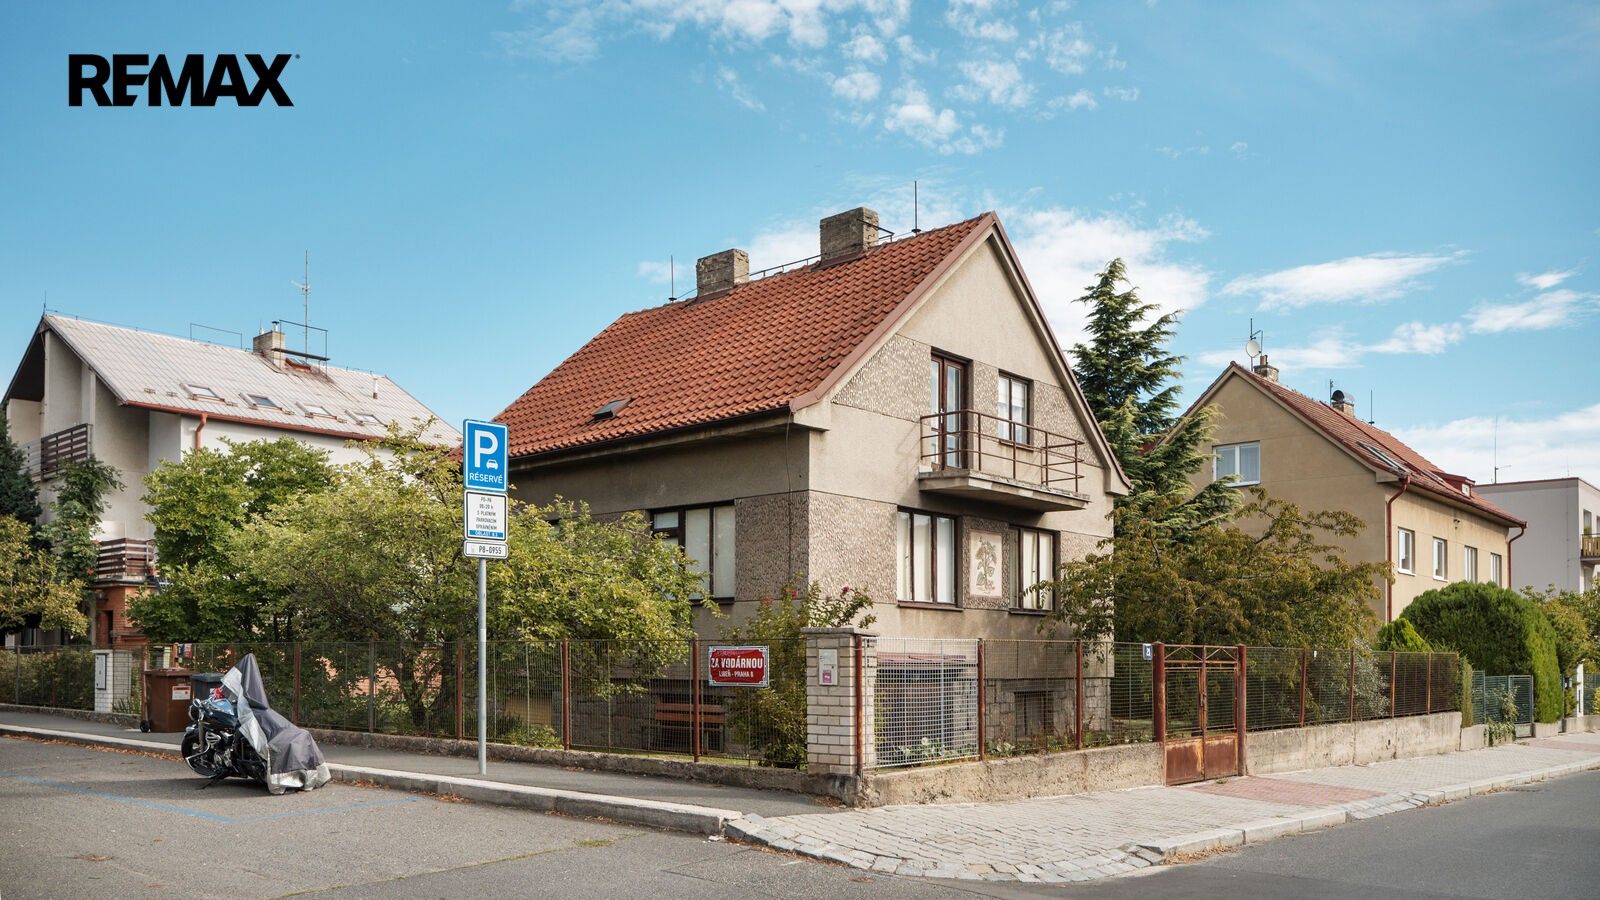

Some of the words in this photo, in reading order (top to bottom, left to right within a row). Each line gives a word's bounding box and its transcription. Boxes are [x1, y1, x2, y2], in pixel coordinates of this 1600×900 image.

[474, 429, 498, 468] P
[469, 471, 503, 484] RÉSERVÉ
[479, 545, 502, 554] P8-0955
[711, 657, 720, 668] ZA
[721, 656, 763, 668] VODÁRNOU
